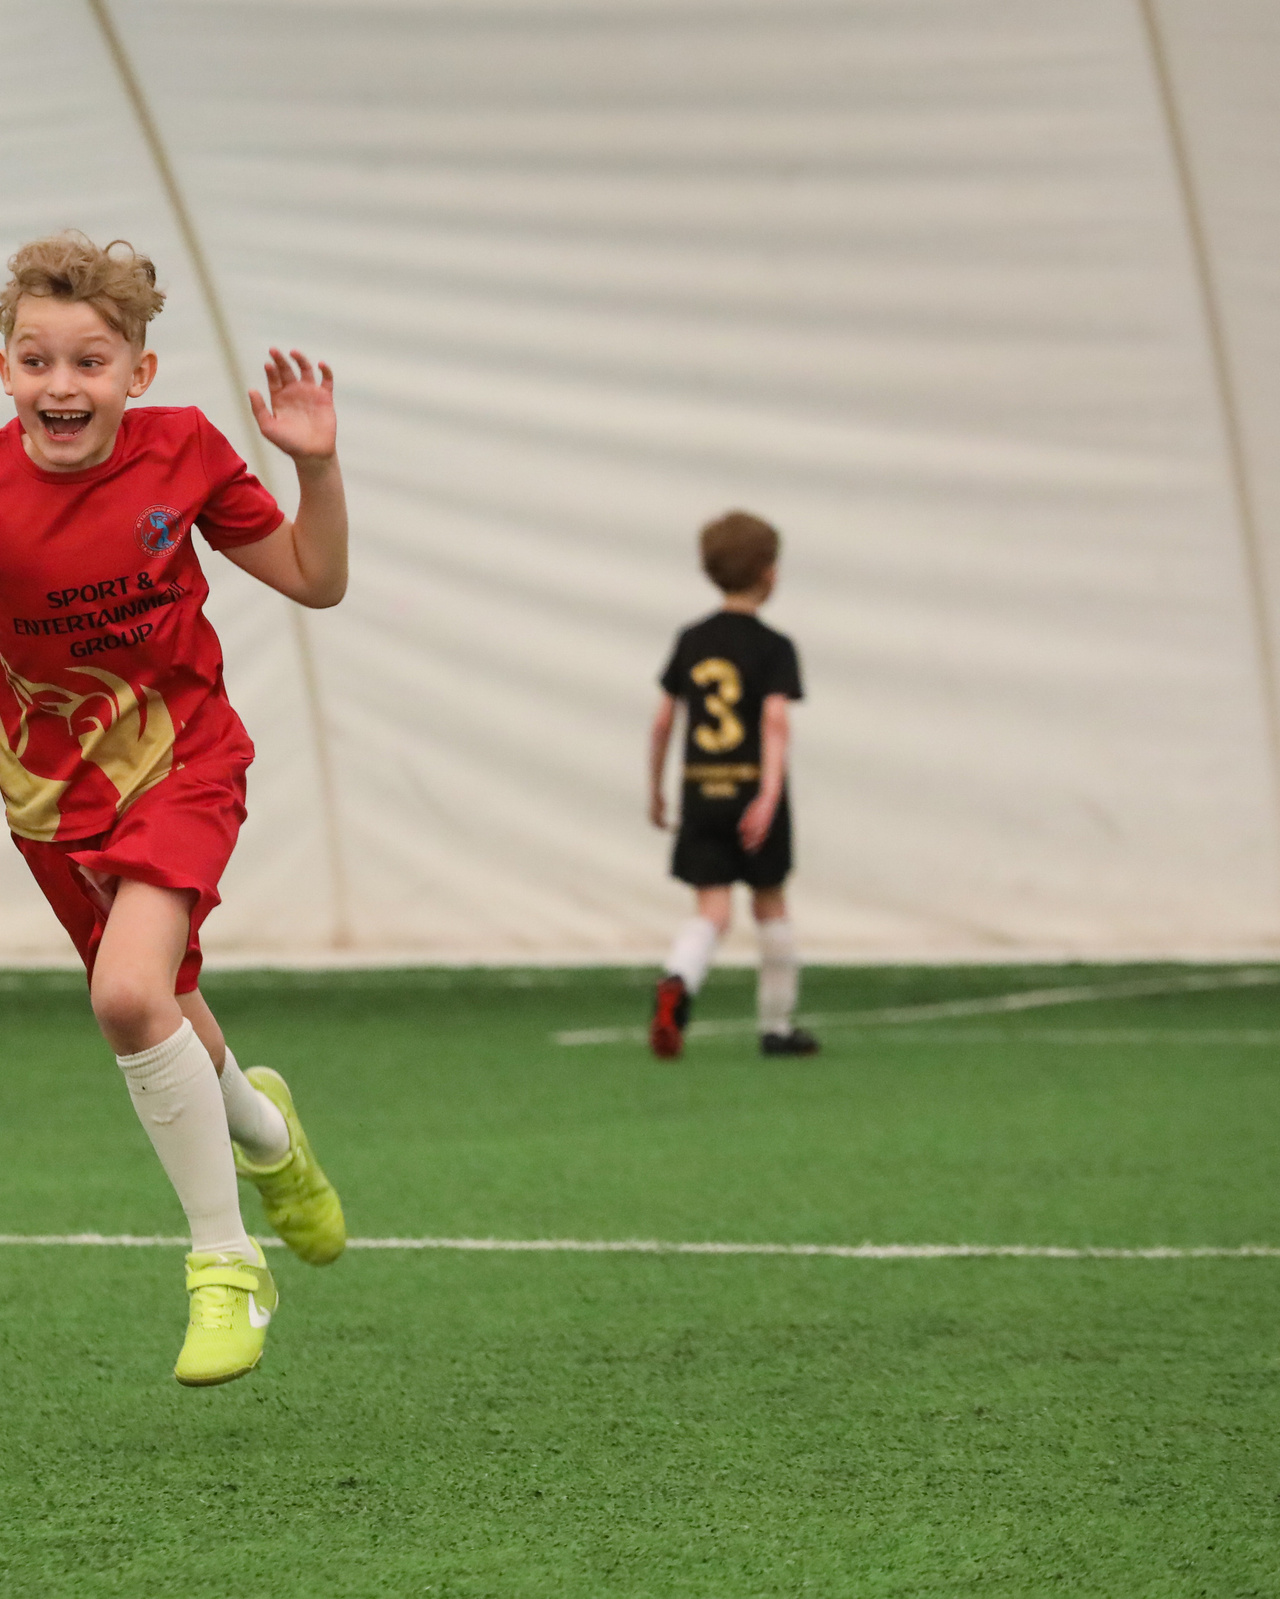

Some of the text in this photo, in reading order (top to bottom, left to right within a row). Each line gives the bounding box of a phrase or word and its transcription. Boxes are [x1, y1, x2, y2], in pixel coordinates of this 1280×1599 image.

[13, 578, 185, 636] ENTERTAINMENT
[47, 572, 155, 609] SPORT &
[70, 623, 153, 658] GROUP
[691, 658, 745, 752] 3
